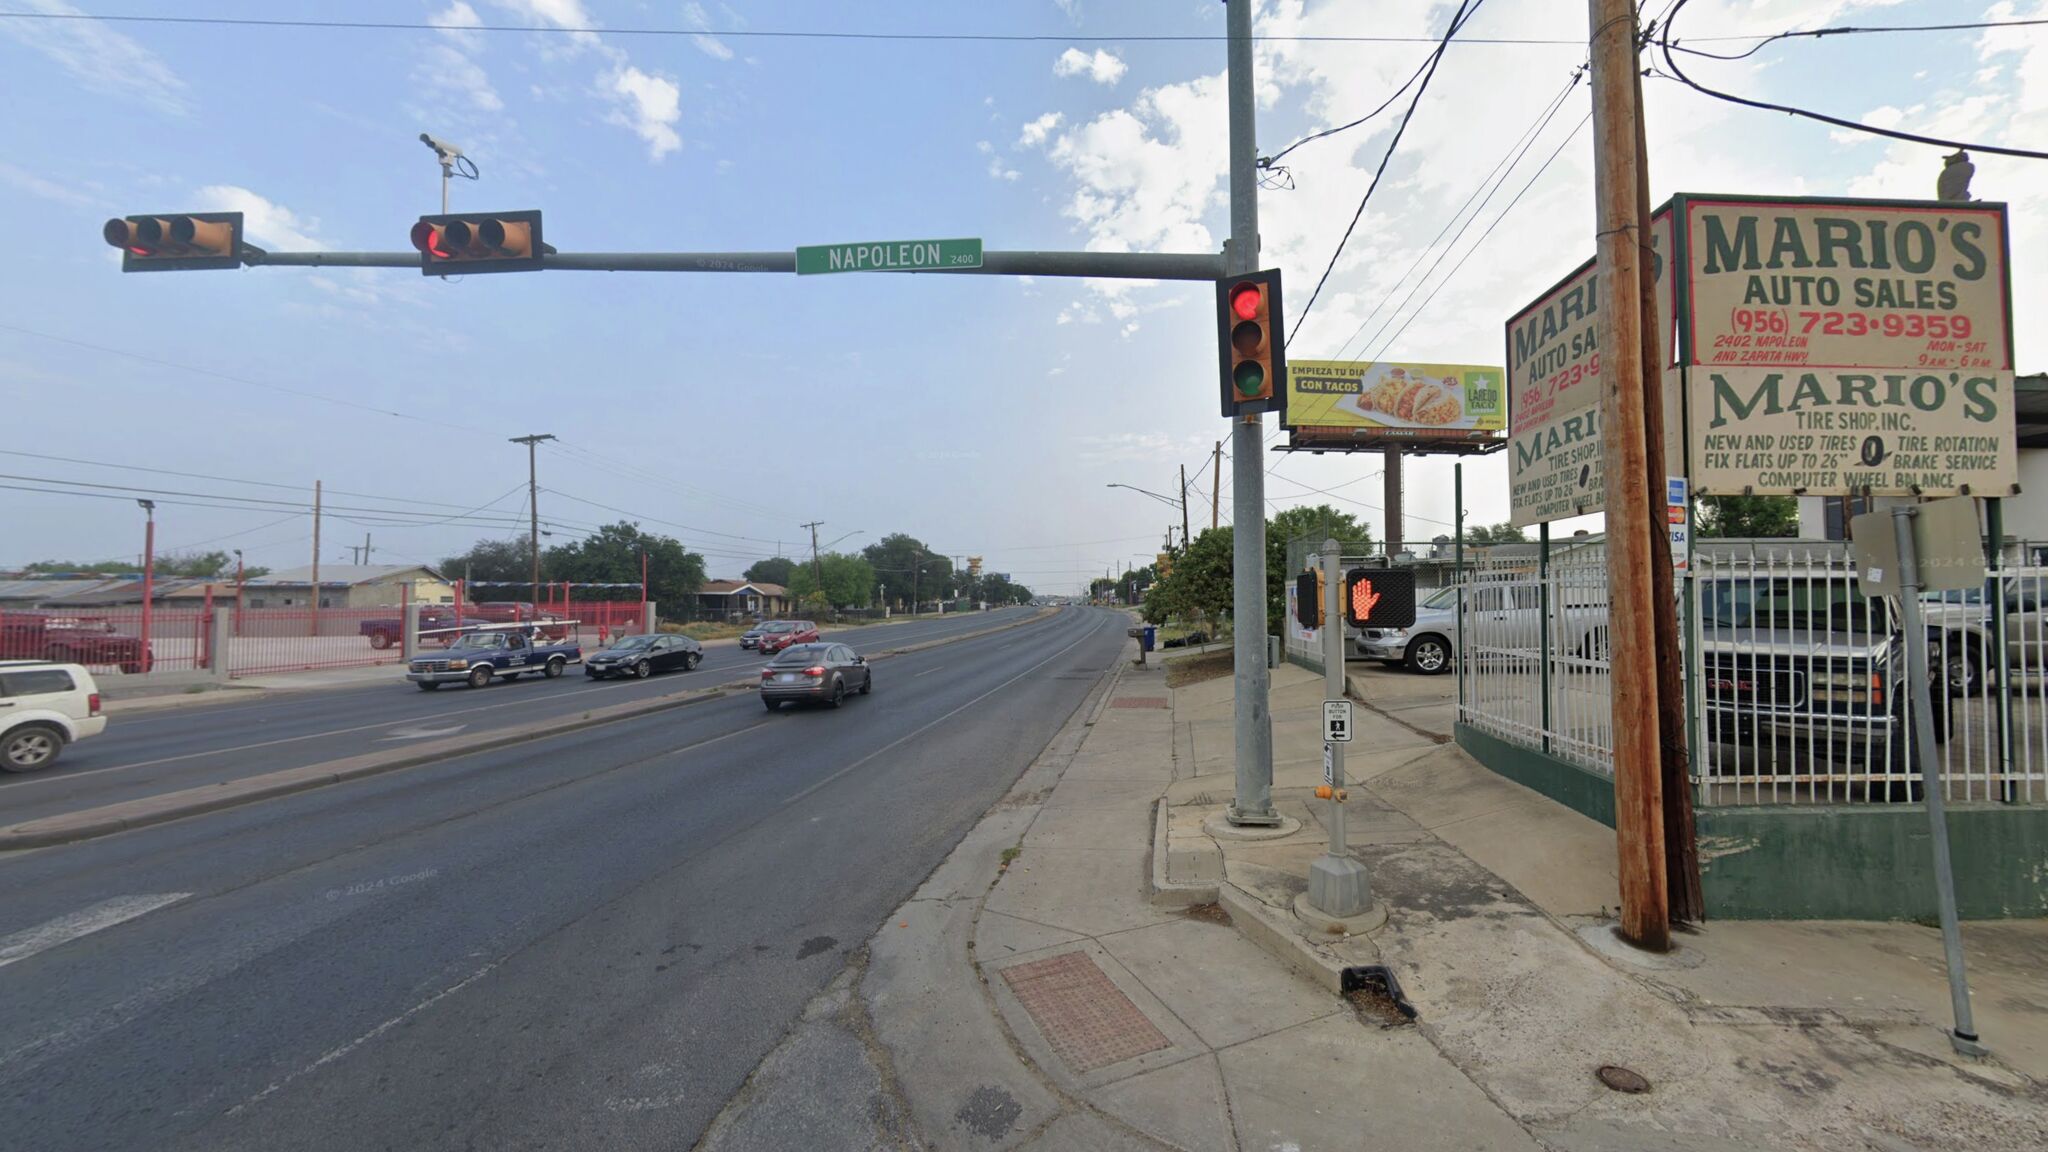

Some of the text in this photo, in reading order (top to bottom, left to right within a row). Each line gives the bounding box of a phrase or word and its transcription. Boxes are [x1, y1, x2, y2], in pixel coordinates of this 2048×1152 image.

[829, 243, 973, 270] NAPOLEON 2400
[1702, 214, 1986, 281] MARIO'S
[1743, 275, 1958, 309] AUTO SALES
[1731, 306, 1789, 336] (956)
[1714, 335, 1809, 348] 2402 NAPOLEON
[1528, 342, 1567, 386] AUTO
[1712, 350, 1737, 362] AND
[1740, 351, 1782, 362] ZAPATA
[1292, 366, 1333, 376] EMPIEZA
[1334, 368, 1347, 376] TU
[1301, 380, 1359, 392] CON TACOS
[1468, 388, 1497, 402] LAREDO
[1472, 401, 1495, 409] TACO
[1710, 372, 1999, 429] MARIO'S
[1795, 411, 1834, 430] TIRE
[1704, 434, 1999, 453] NEW AND USED TIRES TIRE ROTATION
[1548, 453, 1569, 472] TIRE
[1704, 453, 1730, 469] FIX
[1735, 453, 1774, 469] FLATS
[1777, 453, 1798, 469] UP
[1801, 453, 1818, 470] TO
[1893, 454, 1938, 470] BRAKE
[1945, 455, 1997, 471] SERVICE
[1527, 478, 1542, 492] AND
[1542, 473, 1558, 488] USED
[1560, 467, 1578, 483] TIRES
[1758, 471, 1837, 488] COMPUTER
[1843, 472, 1889, 488] WHEEL
[1670, 532, 1685, 542] ISA
